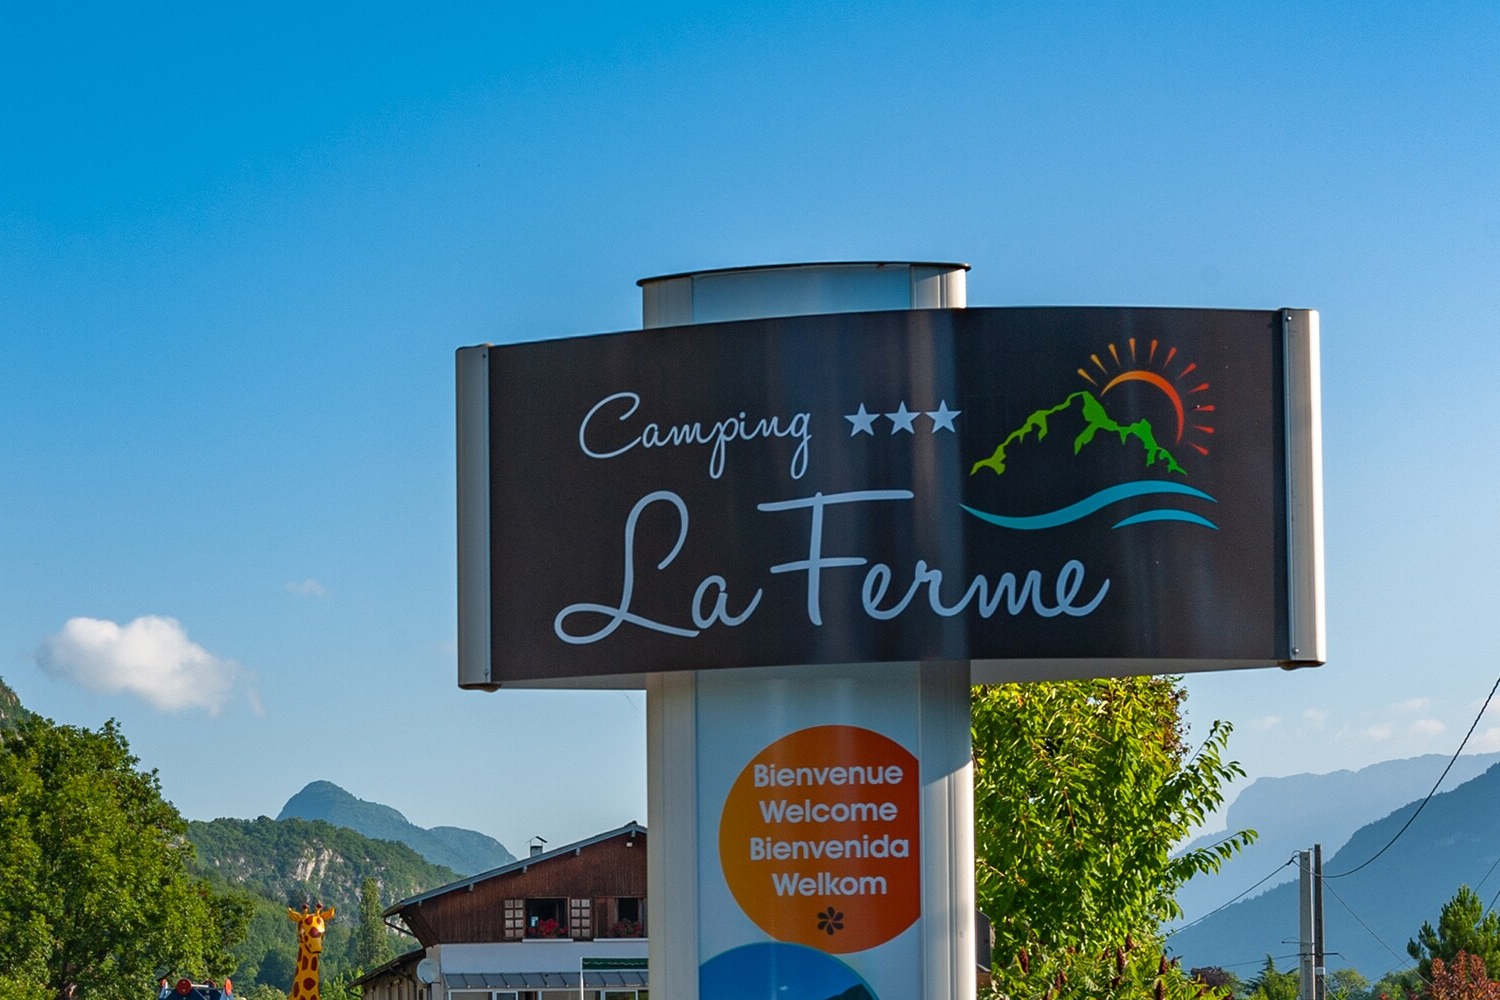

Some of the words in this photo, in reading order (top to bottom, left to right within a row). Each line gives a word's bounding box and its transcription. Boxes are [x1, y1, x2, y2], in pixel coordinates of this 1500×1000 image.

[579, 391, 813, 480] Camping
[554, 490, 766, 645] La
[757, 489, 1111, 628] Ferme
[753, 764, 904, 788] Bienvenue
[758, 799, 898, 824] Welcome
[749, 834, 910, 861] Bienvenida
[771, 872, 887, 897] Welkom
